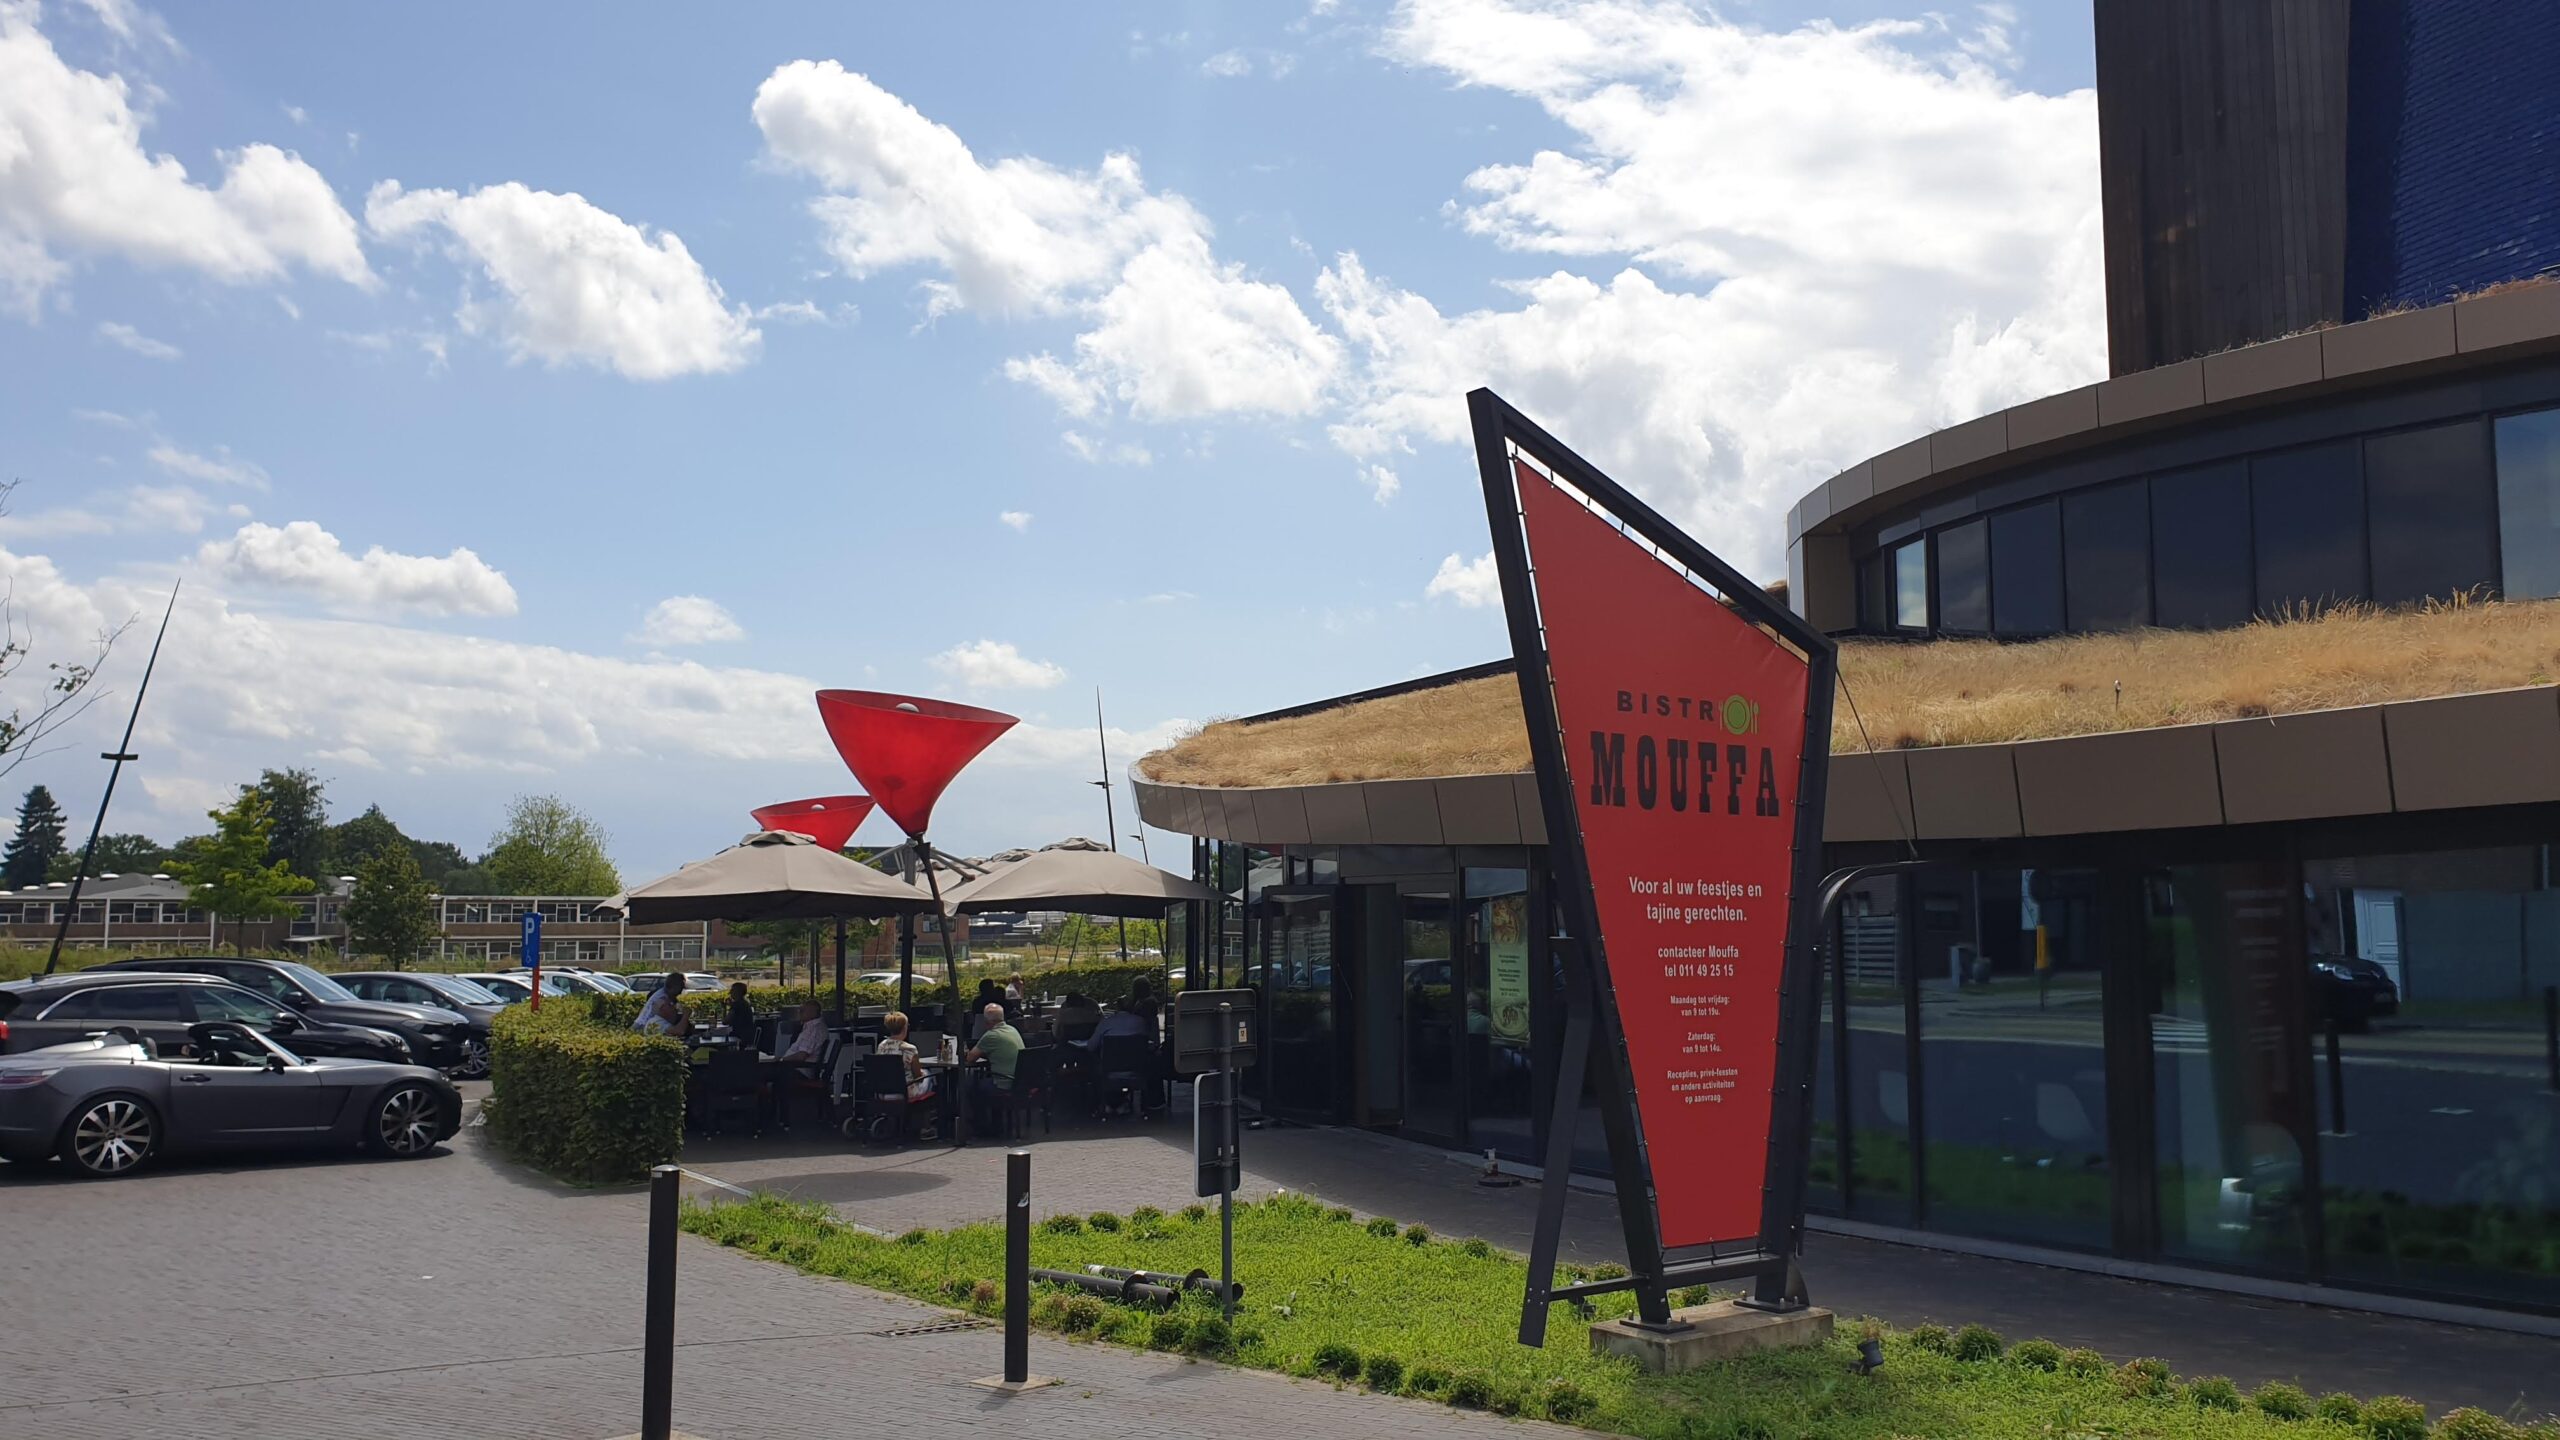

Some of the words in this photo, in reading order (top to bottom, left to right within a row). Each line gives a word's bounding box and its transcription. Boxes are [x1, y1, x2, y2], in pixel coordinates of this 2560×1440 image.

[1590, 731, 1779, 816] MOUFFA
[1629, 876, 1659, 894] Voor
[1662, 878, 1673, 895] al
[1677, 882, 1694, 896] uw
[1697, 879, 1744, 900] feestjes
[1747, 884, 1762, 897] en
[1647, 903, 1681, 924] tajine
[1684, 905, 1747, 924] gerechten.
[525, 917, 535, 946] P
[1658, 946, 1706, 958] contacteer
[1708, 945, 1739, 958] Mouffa
[1665, 965, 1677, 977] tel
[1679, 965, 1694, 977] 011
[1697, 964, 1708, 977] 49
[1710, 964, 1721, 977] 25
[1723, 964, 1734, 977] 15
[1670, 995, 1697, 1006] Maandag
[1698, 995, 1707, 1004] tot
[1698, 1007, 1707, 1016] tot
[1687, 1031, 1716, 1042] Zaterdag:
[1699, 1044, 1708, 1053] tot
[1667, 1069, 1699, 1080] Recepties,
[1681, 1082, 1701, 1091] andere
[1702, 1080, 1735, 1090] activiteiten
[1685, 1095, 1694, 1105] op
